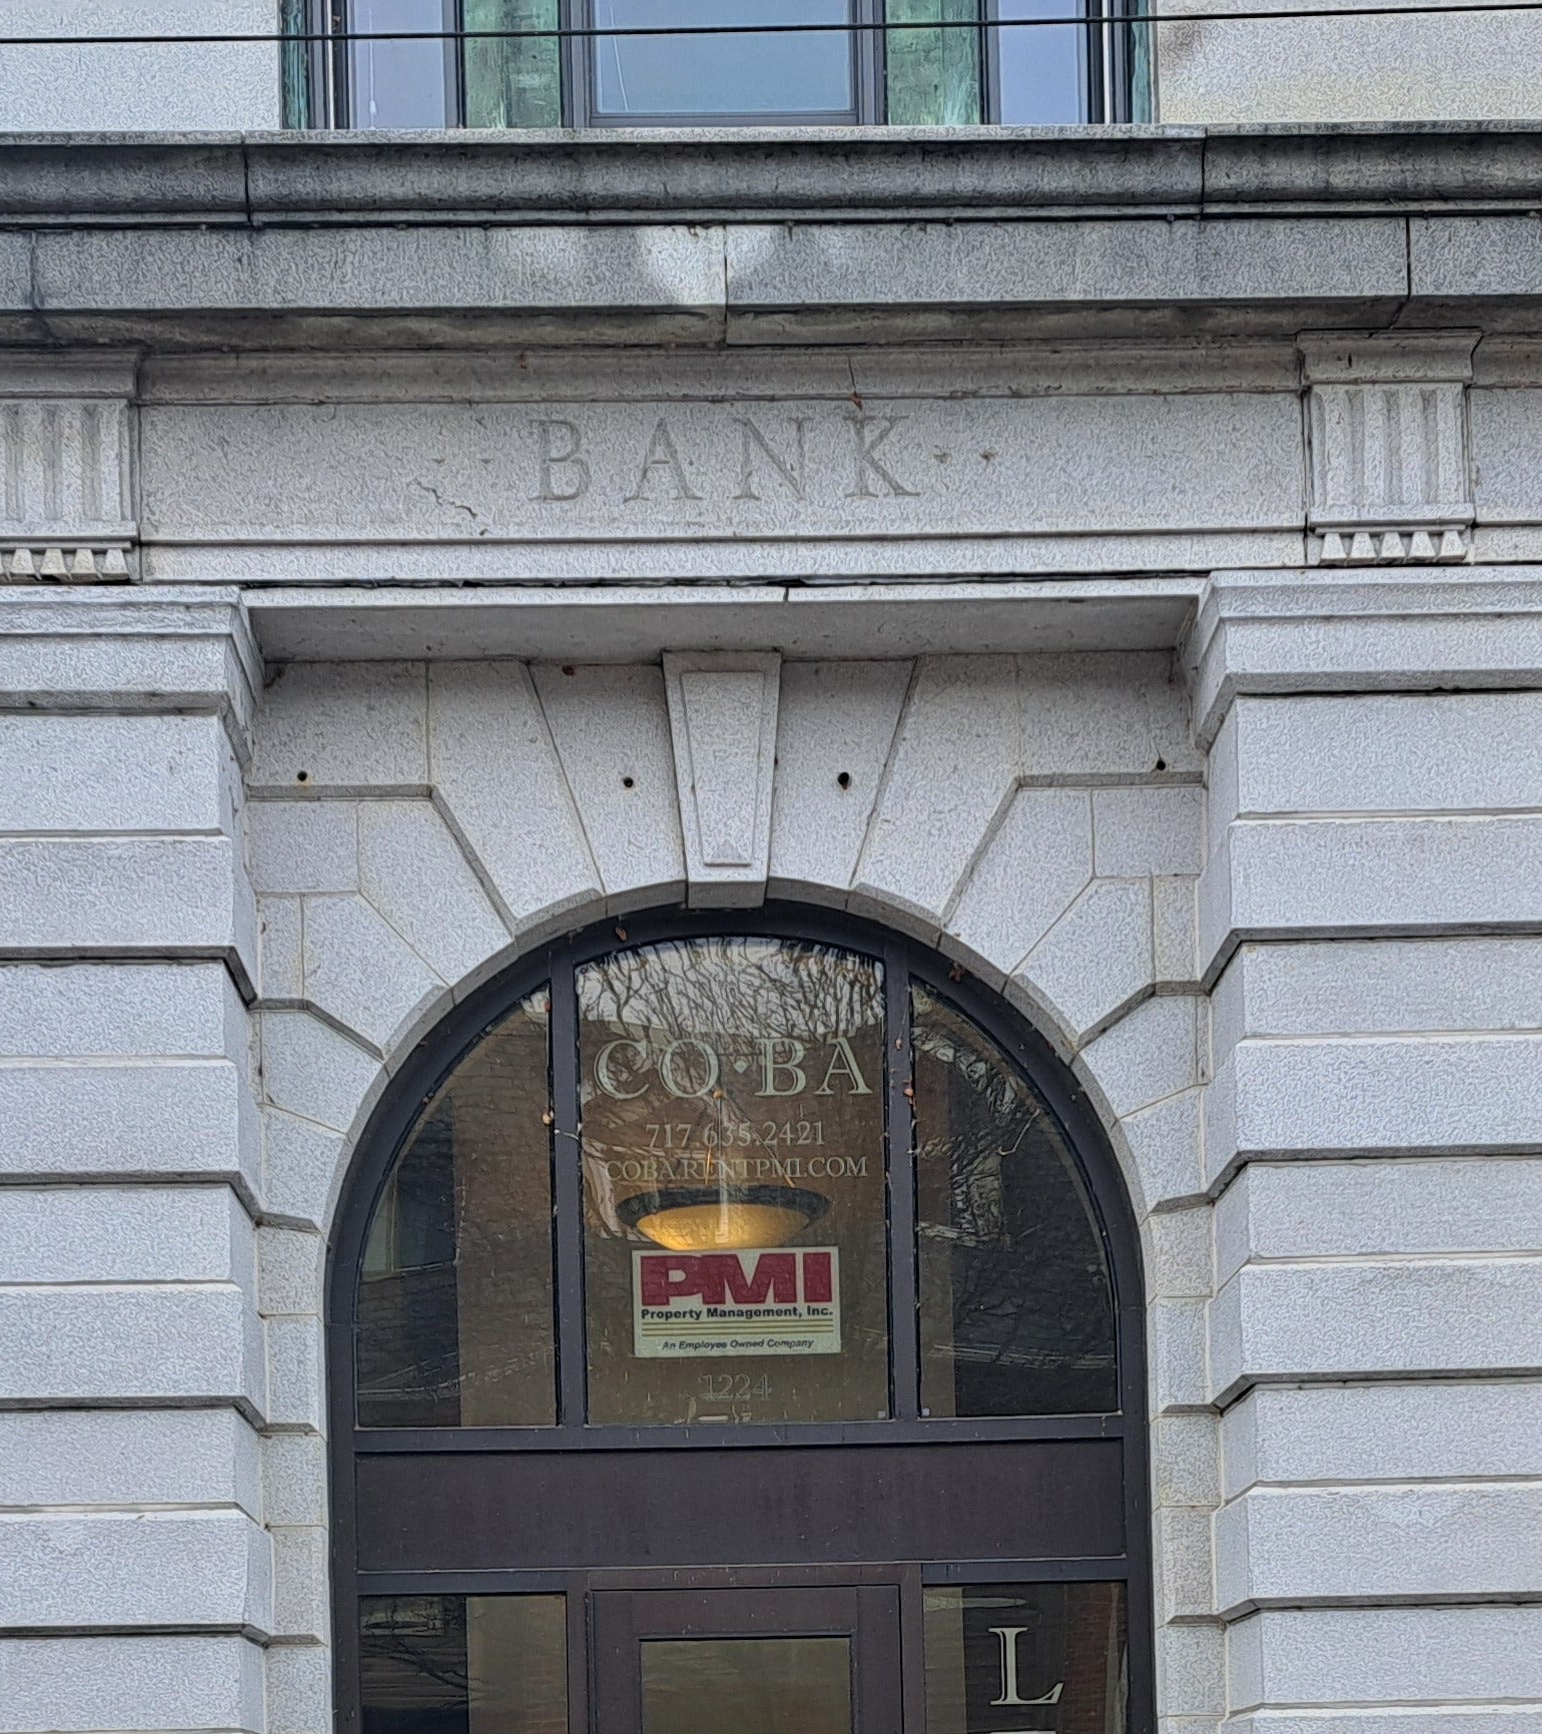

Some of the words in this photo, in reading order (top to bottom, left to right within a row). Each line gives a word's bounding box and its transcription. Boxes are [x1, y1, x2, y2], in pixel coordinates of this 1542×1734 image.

[528, 415, 921, 502] BANK
[640, 1252, 833, 1306] PMI
[641, 1308, 702, 1321] Property
[706, 1306, 802, 1319] Management,
[806, 1305, 833, 1316] Inc.
[662, 1341, 677, 1351] An
[679, 1340, 727, 1351] Employee
[730, 1339, 764, 1349] Owned
[767, 1338, 814, 1349] Company
[699, 1374, 771, 1402] 1224
